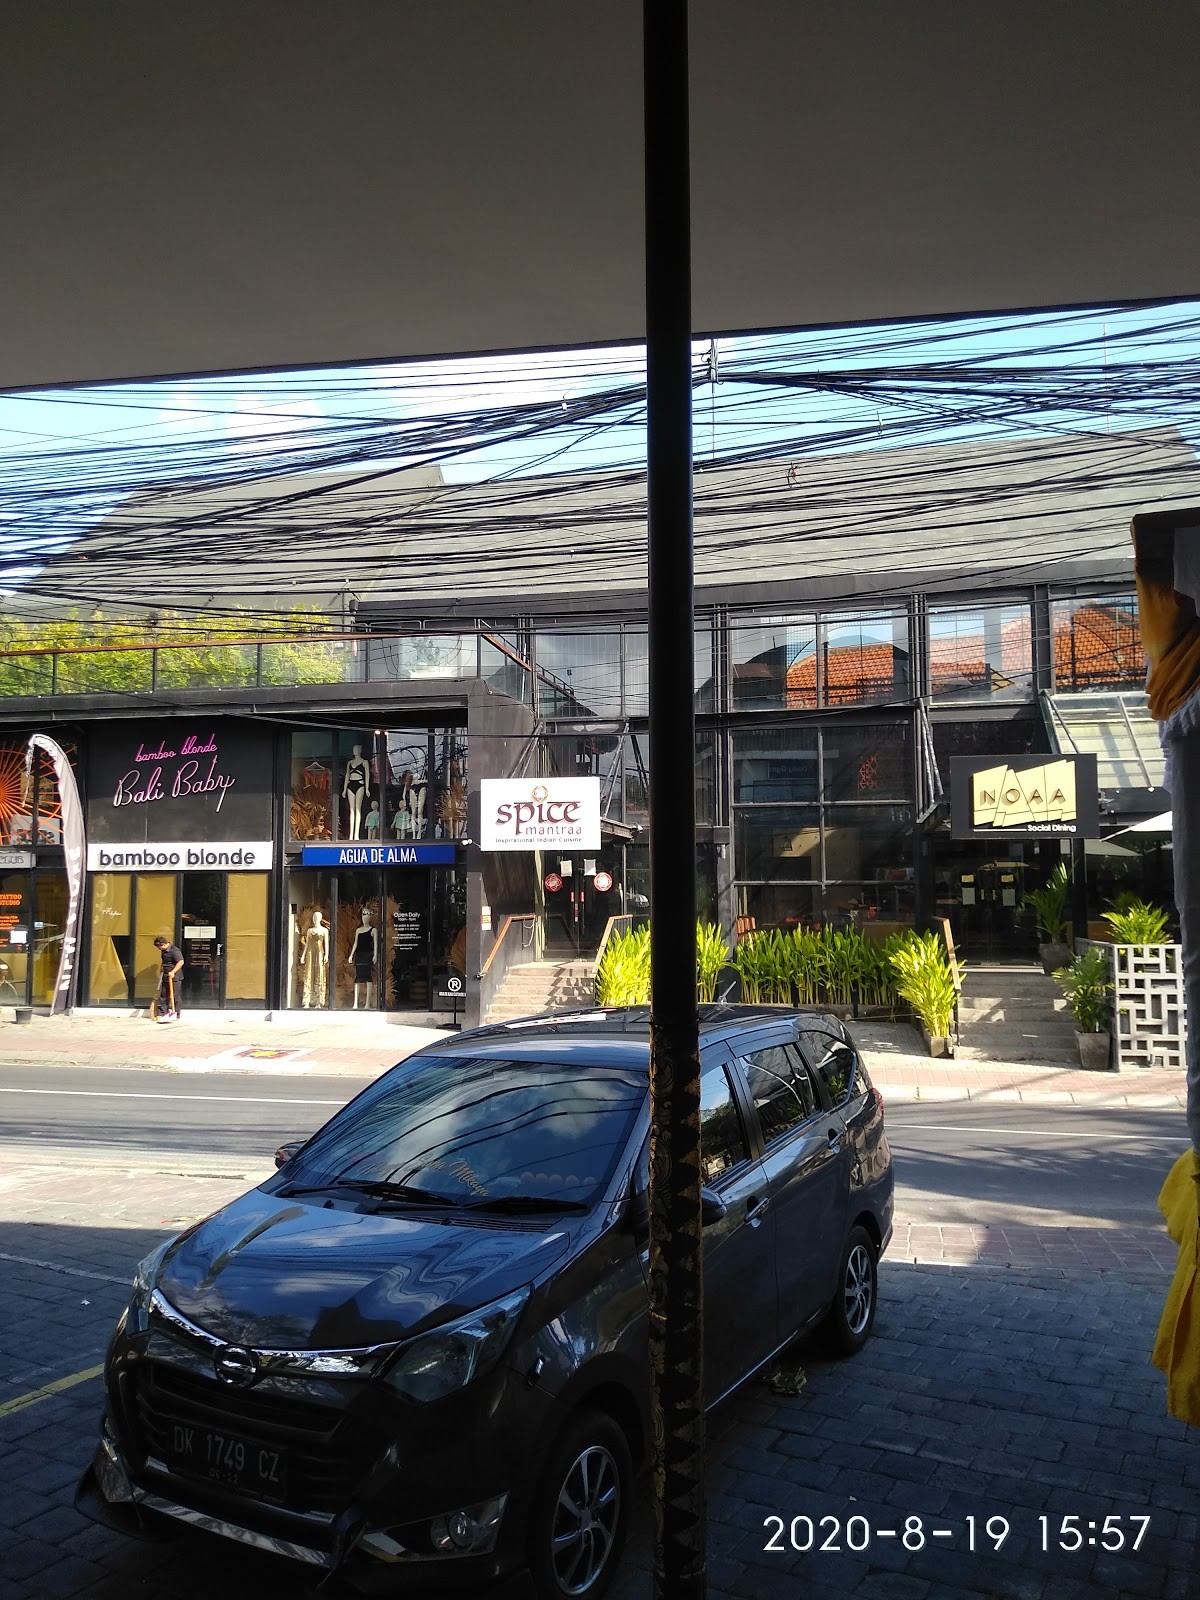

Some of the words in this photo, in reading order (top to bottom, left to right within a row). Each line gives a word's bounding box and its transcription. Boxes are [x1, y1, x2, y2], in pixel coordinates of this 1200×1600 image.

[135, 741, 177, 762] bamboo
[181, 733, 218, 755] blonde
[113, 767, 165, 807] Bali
[172, 755, 236, 813] Baby
[982, 788, 1067, 805] NOAA
[496, 801, 582, 836] spice
[525, 826, 582, 835] mantraa
[1027, 824, 1050, 832] Social
[1052, 824, 1077, 833] Dining
[100, 849, 181, 866] bamboo
[187, 848, 256, 865] blonde
[339, 848, 368, 864] AGUA
[371, 848, 384, 863] DE
[387, 848, 417, 863] ALMA
[173, 1425, 195, 1456] DK
[207, 1434, 246, 1471] 1749
[258, 1449, 280, 1483] CZ
